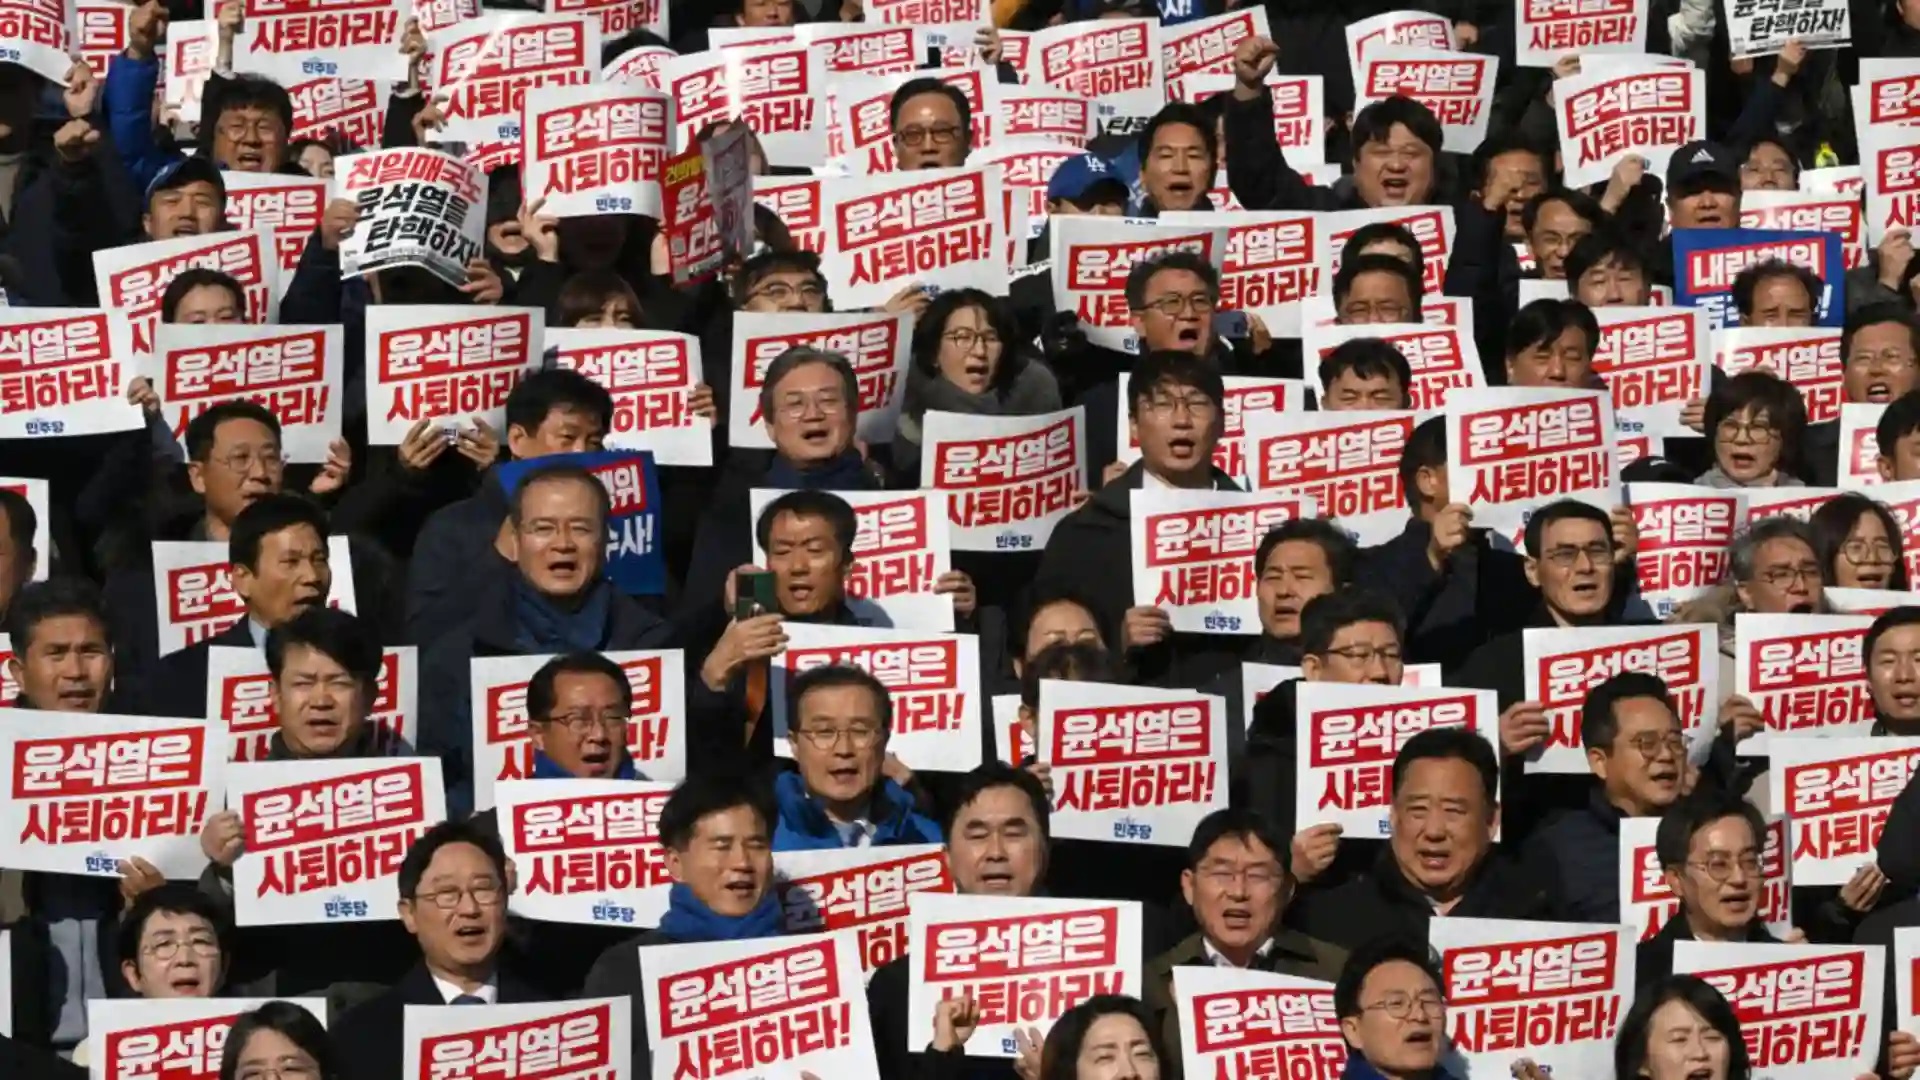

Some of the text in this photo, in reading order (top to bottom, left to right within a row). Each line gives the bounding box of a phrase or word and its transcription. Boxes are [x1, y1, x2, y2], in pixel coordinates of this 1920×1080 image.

[251, 10, 398, 54] 사퇴하라!
[1529, 16, 1636, 50] 사퇴하라!
[288, 78, 373, 121] 석열은
[1373, 63, 1475, 93] 윤석열은
[1571, 75, 1684, 132] 윤석열은
[498, 124, 520, 138] 민주
[544, 102, 664, 155] 윤석열은
[1579, 116, 1695, 168] 사퇴하라!
[545, 143, 668, 196] 사퇴하라
[227, 187, 317, 230] 석열은
[844, 176, 977, 246] 윤석열은
[850, 223, 991, 286] 사퇴하라!
[176, 338, 315, 394] 윤석열은
[388, 319, 521, 375] 윤석열은
[1598, 320, 1688, 366] 석열은
[386, 369, 524, 422] 사퇴하라
[612, 391, 692, 432] 하라!
[1613, 364, 1701, 410] 하라!
[944, 421, 1070, 483] 윤석열은
[1266, 423, 1405, 480] 윤석열은
[1468, 402, 1596, 457] 윤석열은
[1470, 451, 1609, 504] 사퇴하라!
[851, 503, 916, 552] 열은
[1641, 500, 1729, 548] 석열은
[845, 554, 934, 601] 하라!
[1154, 563, 1257, 608] 사퇴하
[1205, 616, 1241, 631] 민주당
[1758, 636, 1865, 686] 윤석열
[1061, 706, 1202, 760] 윤석열은
[1763, 685, 1874, 732] 사퇴하
[23, 733, 192, 792] 윤석열은
[1057, 761, 1216, 813] 사퇴하라!
[1793, 752, 1920, 814] 윤석열
[20, 790, 207, 845] 사퇴하라!
[254, 771, 414, 845] 윤석열은
[1113, 823, 1152, 840] 민주당
[86, 856, 120, 873] 민주
[257, 826, 420, 898] 사퇴하라
[325, 900, 368, 917] 민주당
[592, 904, 637, 923] 민주당
[936, 915, 1106, 975] 윤석열은
[1452, 939, 1607, 1001] 윤석열은
[669, 948, 828, 1031] 윤석열은
[674, 1002, 851, 1080] 사퇴하라!
[1204, 993, 1340, 1045] 윤석열은
[1452, 995, 1620, 1054] 사퇴하라!
[430, 1013, 600, 1080] 윤석열은
